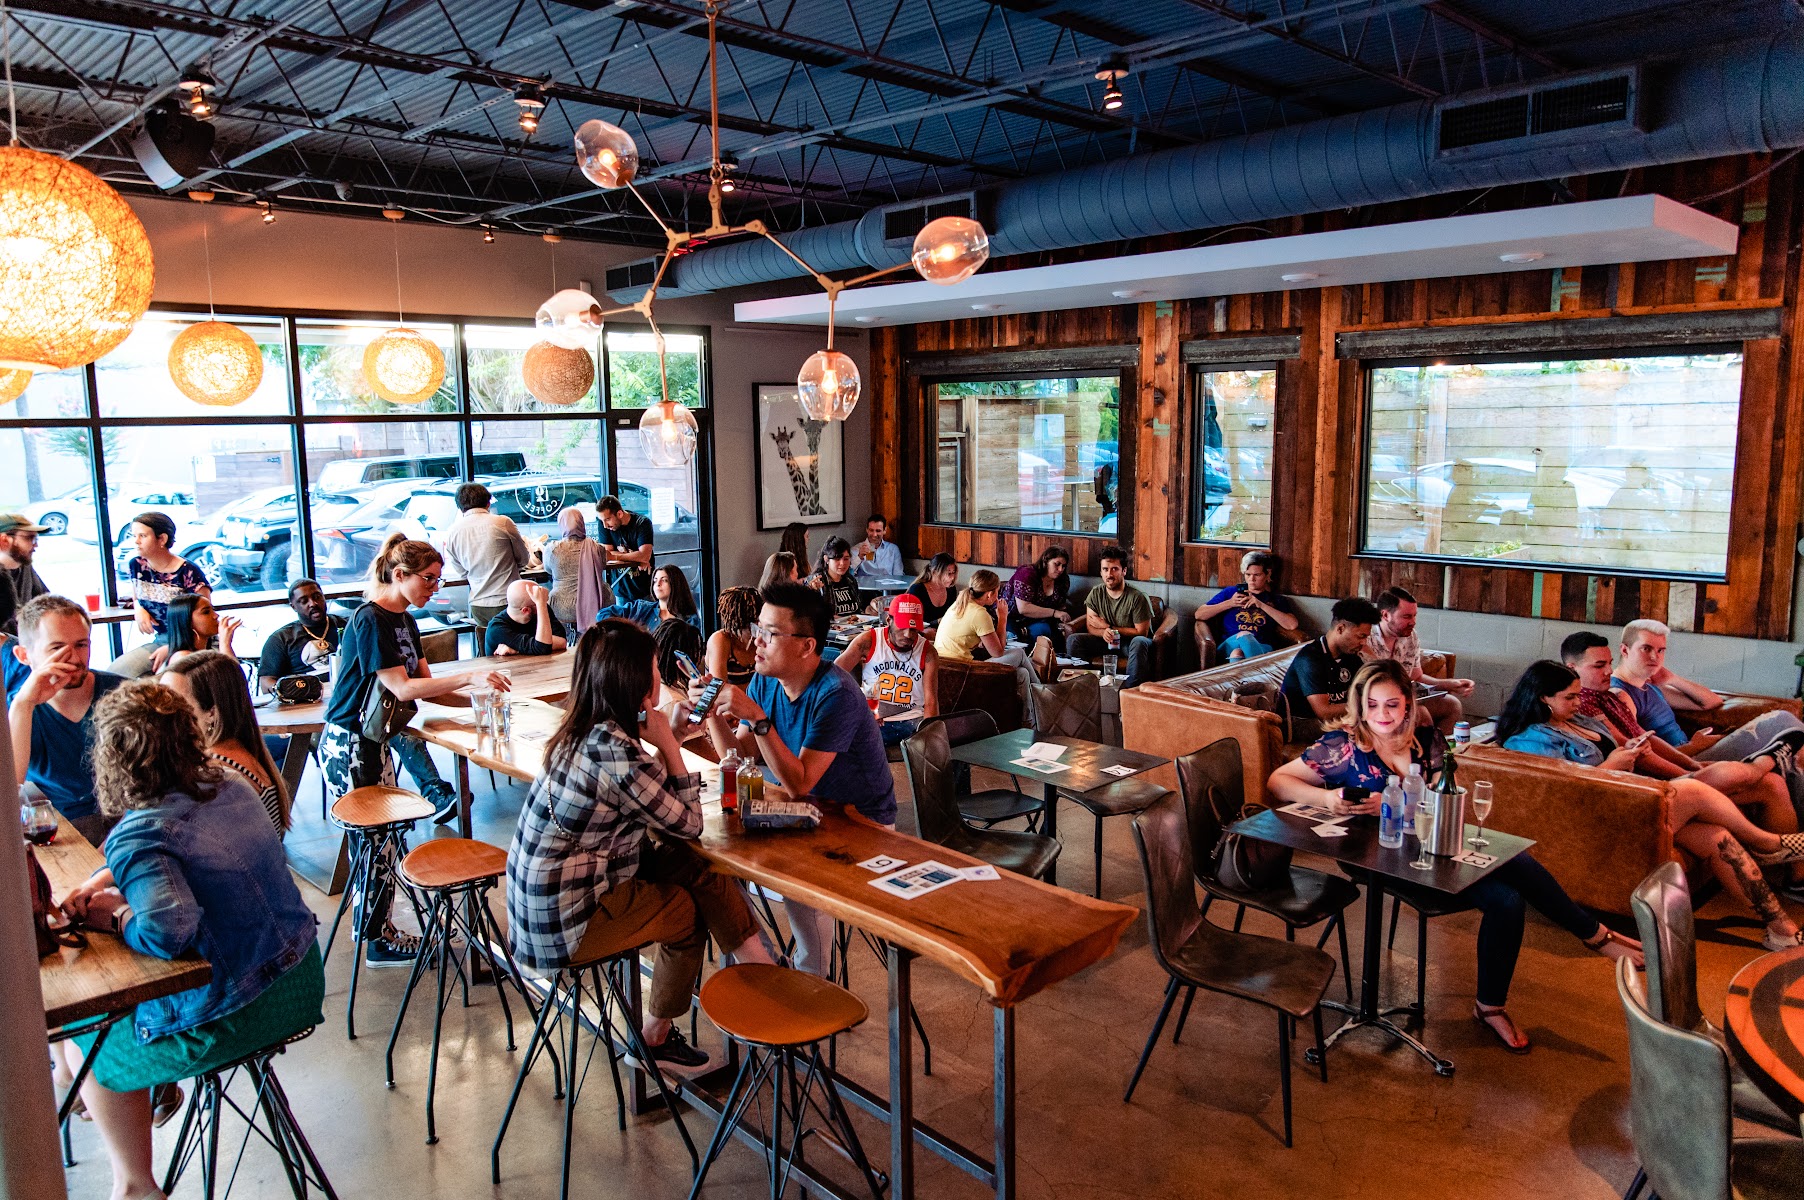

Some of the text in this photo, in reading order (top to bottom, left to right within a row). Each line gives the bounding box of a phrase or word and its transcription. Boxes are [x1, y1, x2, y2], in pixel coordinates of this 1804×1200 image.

[873, 660, 922, 682] MCDONALD'S
[879, 672, 914, 704] 22
[1462, 852, 1492, 866] 13
